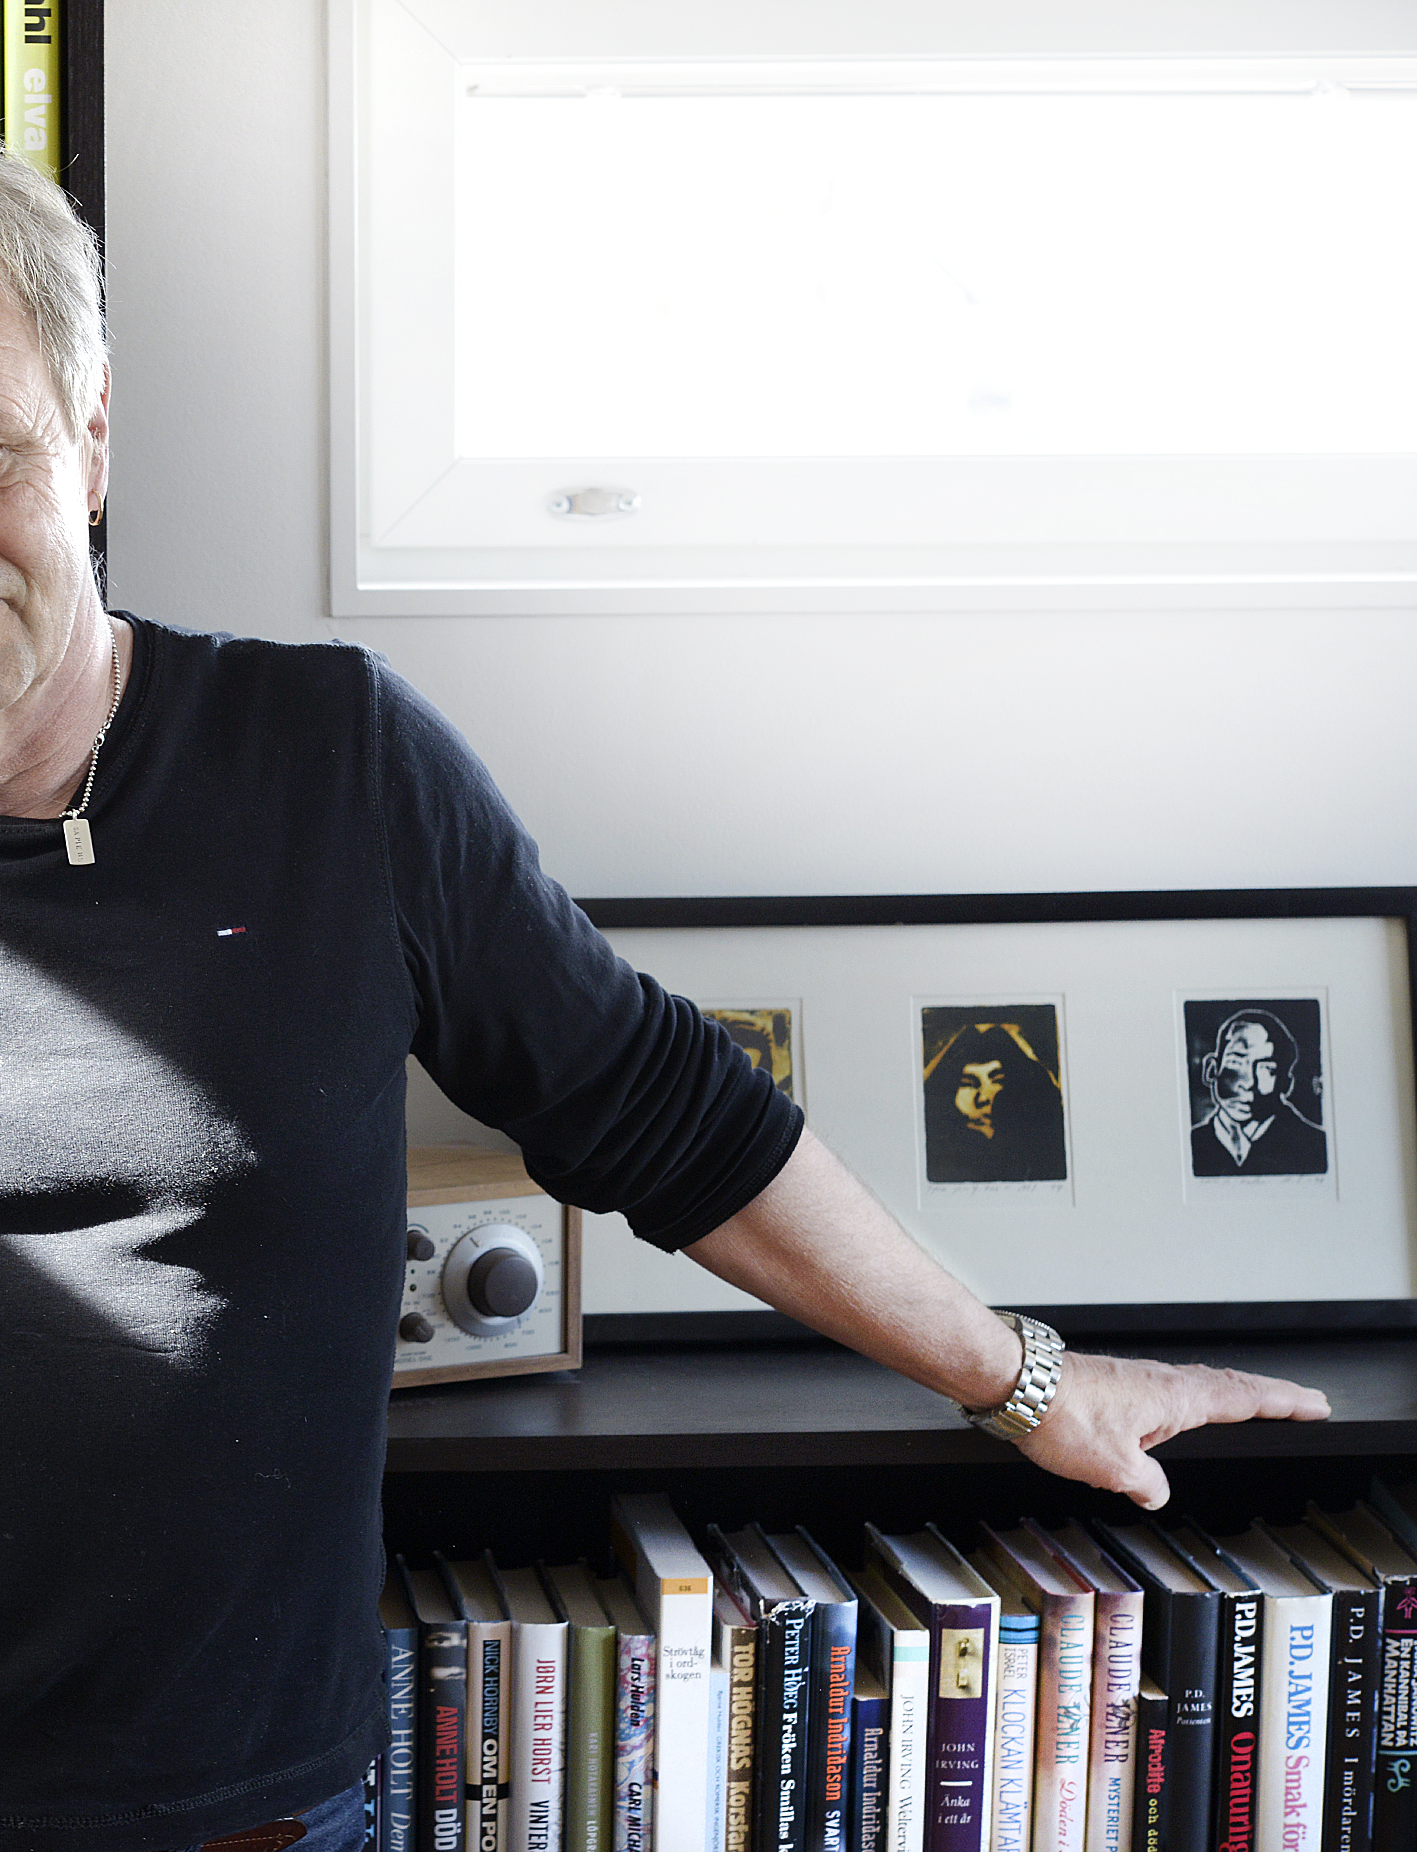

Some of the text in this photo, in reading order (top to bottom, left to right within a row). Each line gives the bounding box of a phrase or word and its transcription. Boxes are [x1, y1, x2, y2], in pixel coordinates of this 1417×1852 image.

[23, 67, 52, 152] elva
[784, 1618, 804, 1666] PETER
[827, 1645, 852, 1714] Arnaldur
[1231, 1601, 1258, 1719] P.D. JAMES
[1285, 1624, 1315, 1752] P.D. JAMES
[1344, 1606, 1366, 1739] P.D. JAMES
[389, 1643, 416, 1801] ANNE HOLT
[482, 1641, 500, 1816] NICK HORNBY OM EN
[527, 1658, 558, 1852] JØRN LIER HORST VINTER
[781, 1712, 799, 1775] Fröken
[935, 1759, 980, 1770] IRVING
[941, 1742, 976, 1753] JOHN
[432, 1705, 463, 1852] ANNE HOLT DÖD
[778, 1778, 796, 1842] Smillas
